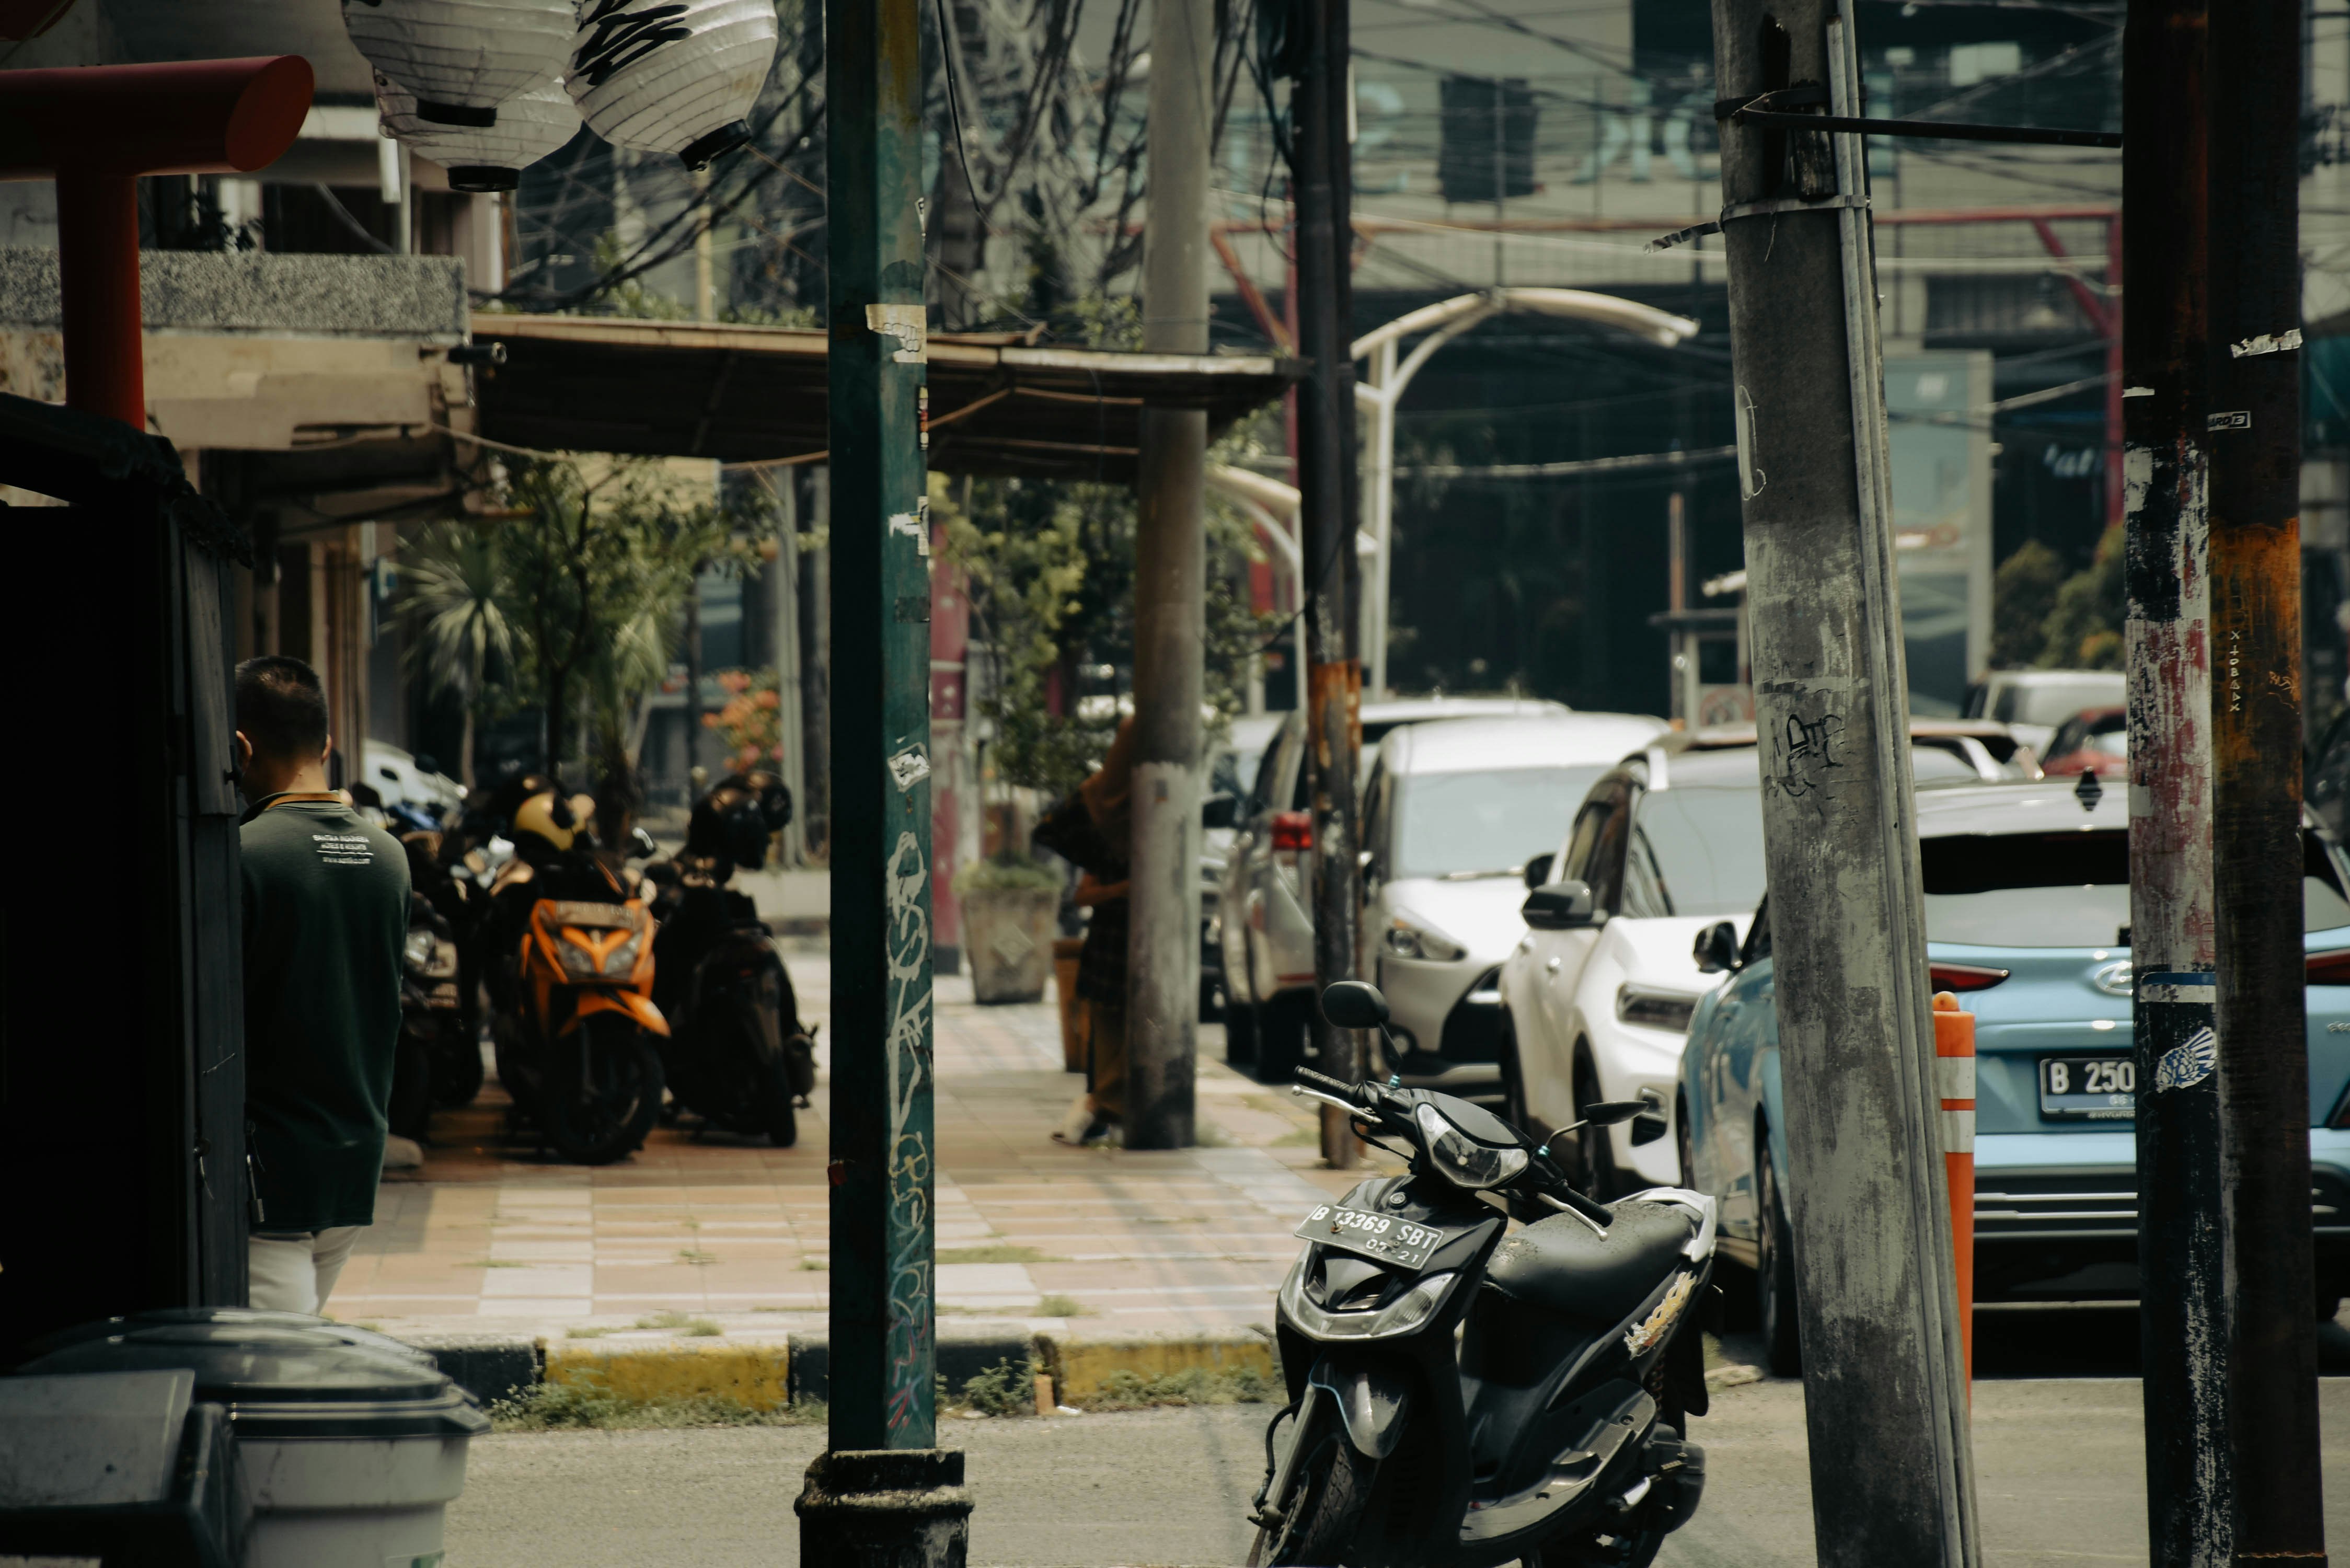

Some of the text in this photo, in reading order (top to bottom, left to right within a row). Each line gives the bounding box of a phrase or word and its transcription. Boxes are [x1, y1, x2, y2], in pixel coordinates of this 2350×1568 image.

[2051, 1062, 2070, 1094] B
[1311, 1206, 1330, 1221] B
[1396, 1225, 1438, 1250] SBT
